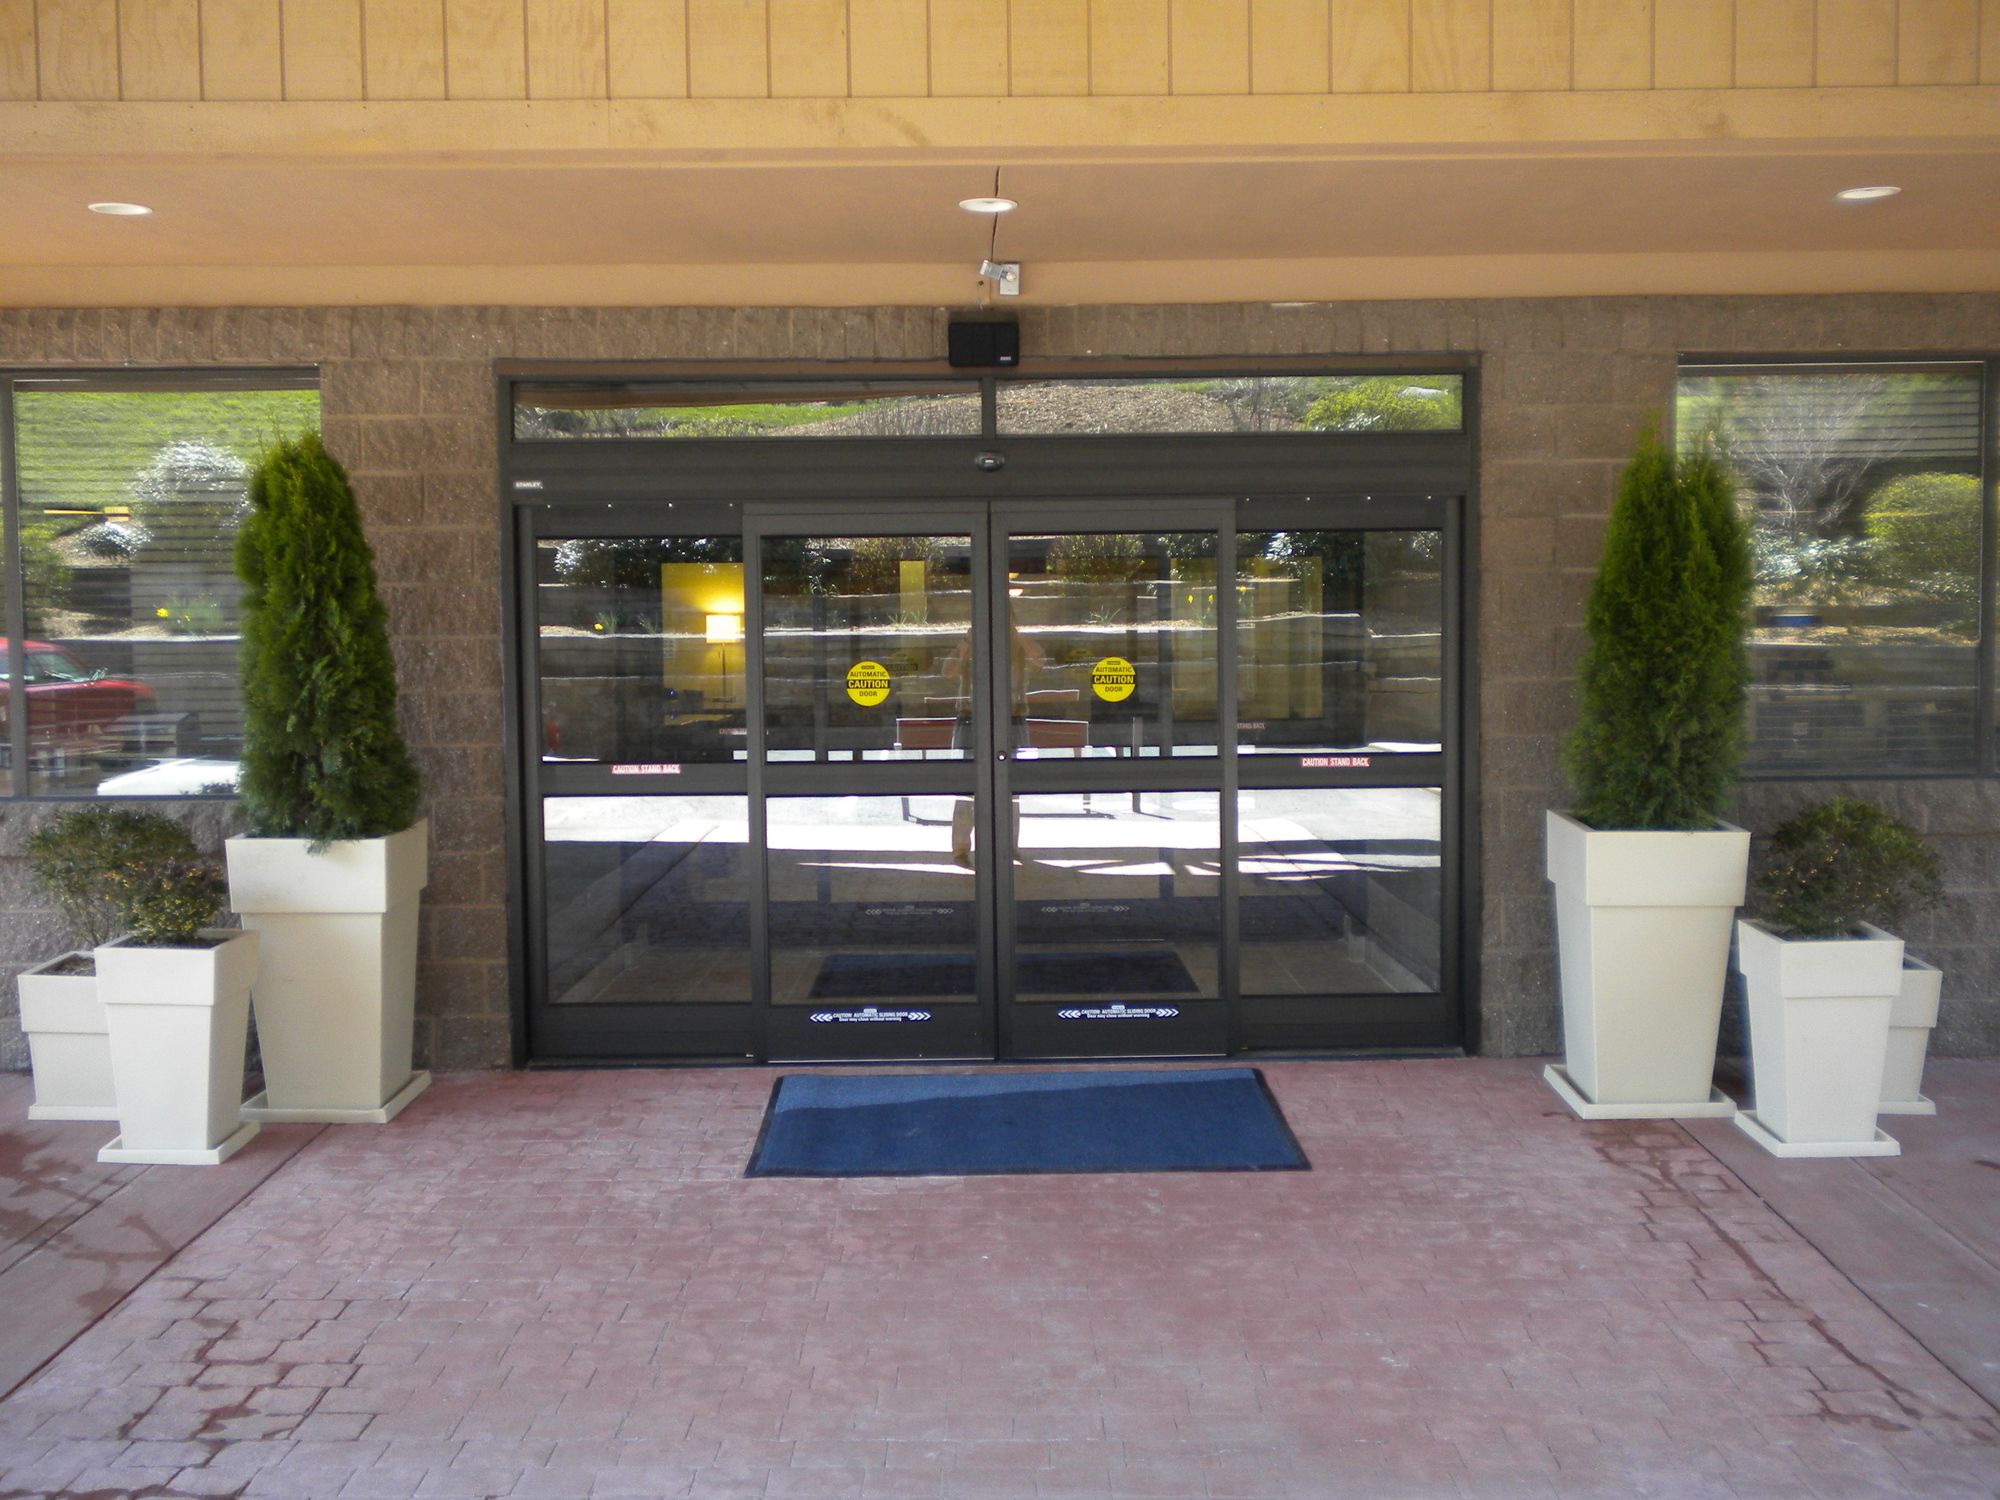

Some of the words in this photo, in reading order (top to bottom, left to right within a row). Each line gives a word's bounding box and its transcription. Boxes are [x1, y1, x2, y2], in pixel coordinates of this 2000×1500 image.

[848, 680, 888, 688] CAUTION
[1094, 676, 1134, 684] CAUTION
[1302, 758, 1328, 767] CAUTION
[1330, 758, 1350, 767] STAND
[1352, 758, 1369, 767] BACK
[612, 765, 638, 774] CAUTION
[640, 764, 660, 774] STAND
[662, 764, 680, 774] BACK
